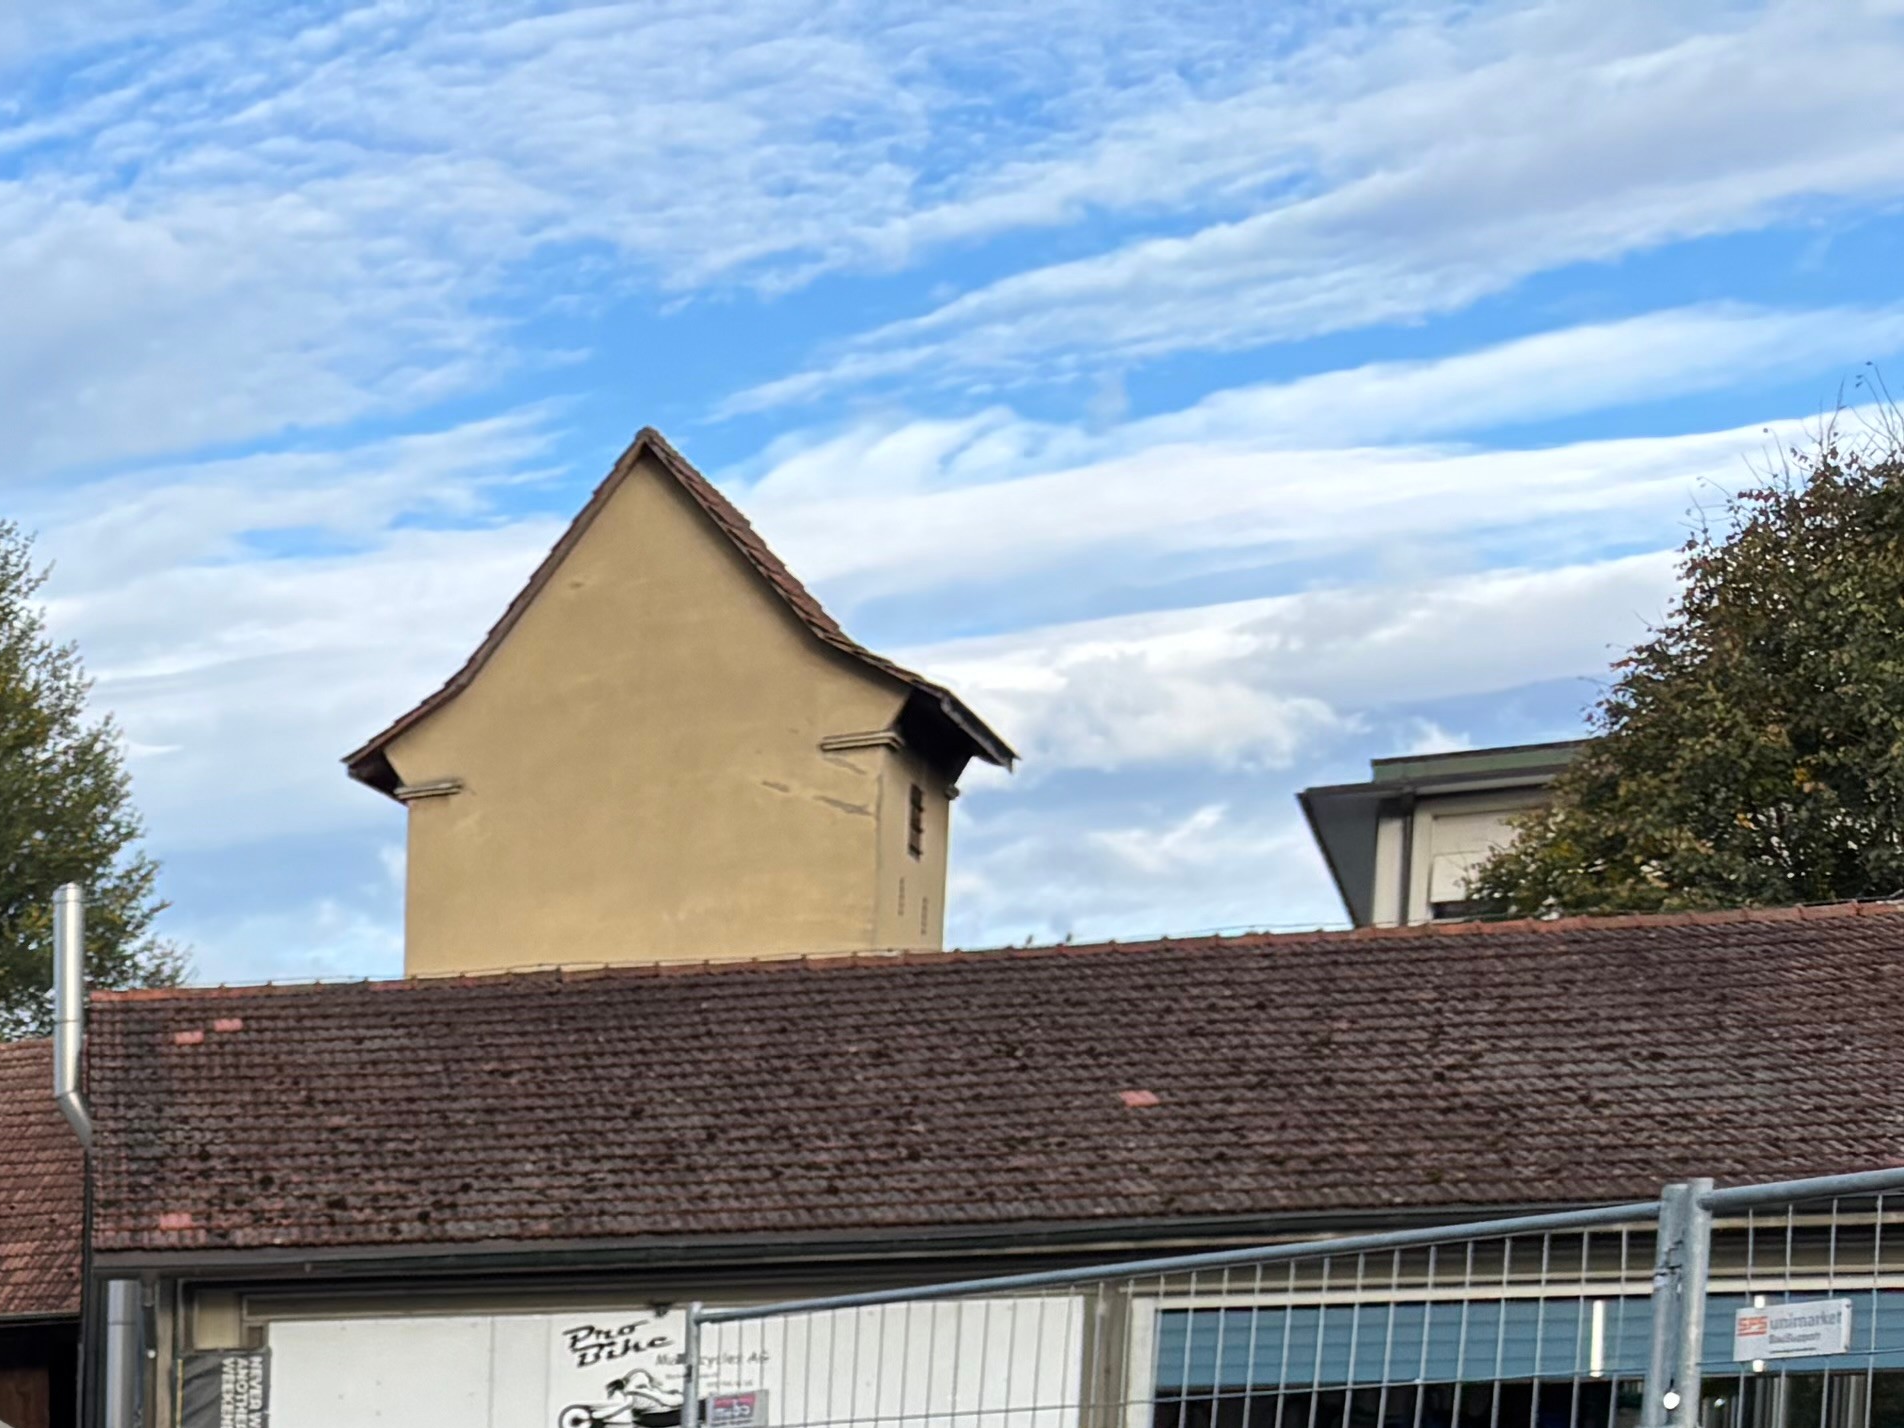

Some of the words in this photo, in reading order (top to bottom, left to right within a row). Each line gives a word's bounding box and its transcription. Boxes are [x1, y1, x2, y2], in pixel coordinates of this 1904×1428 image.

[562, 1319, 650, 1349] Pro
[571, 1336, 675, 1368] Bike
[248, 1355, 263, 1410] NEVER
